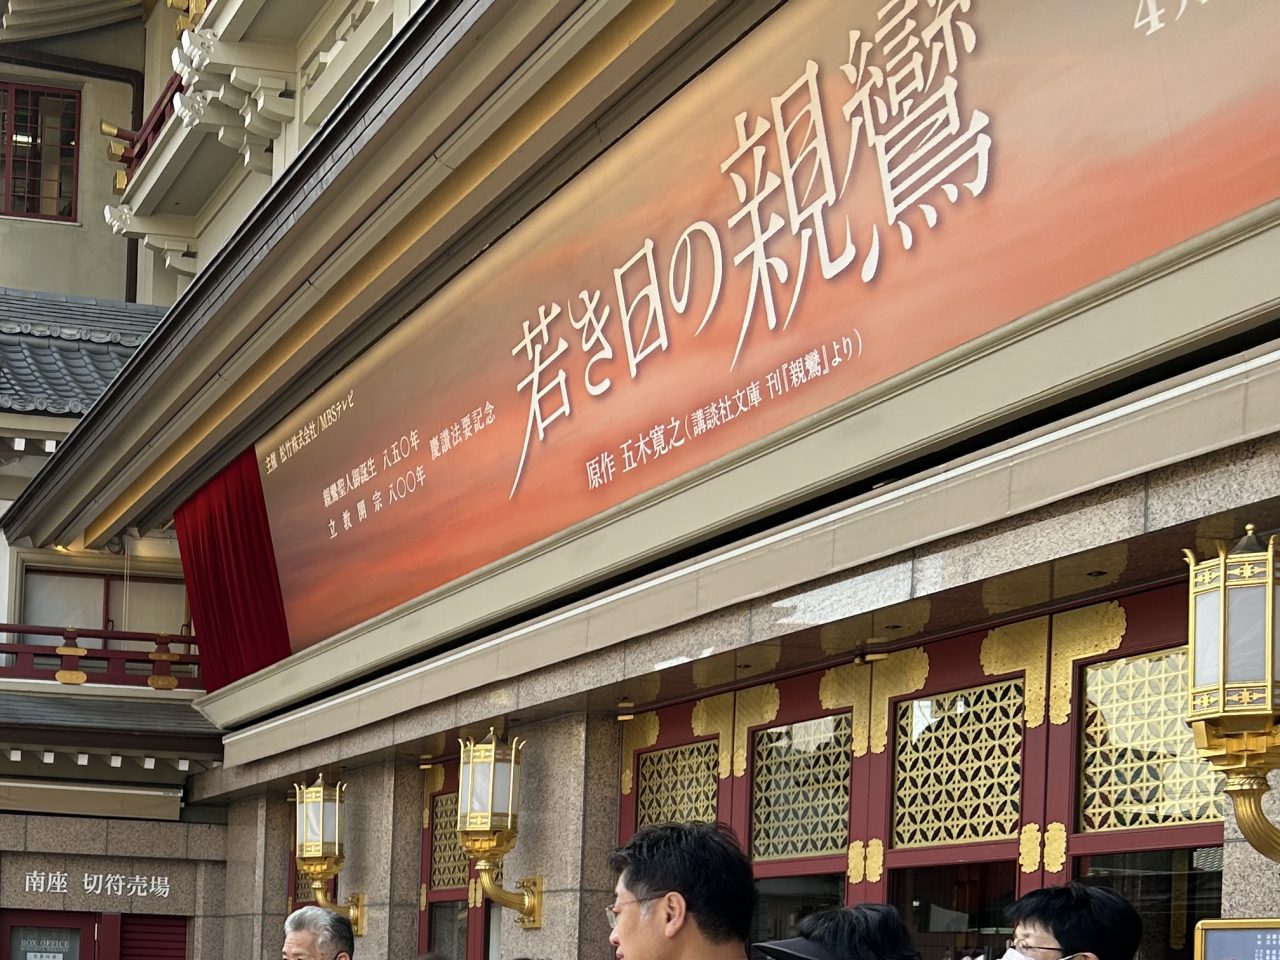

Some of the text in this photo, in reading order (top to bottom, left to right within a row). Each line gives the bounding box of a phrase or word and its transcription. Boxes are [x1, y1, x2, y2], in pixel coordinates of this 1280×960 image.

[508, 0, 993, 501] 若き日の親鸞
[585, 451, 617, 491] 原作
[24, 870, 171, 898] 南座 切符売場
[40, 939, 70, 948] OFFICE
